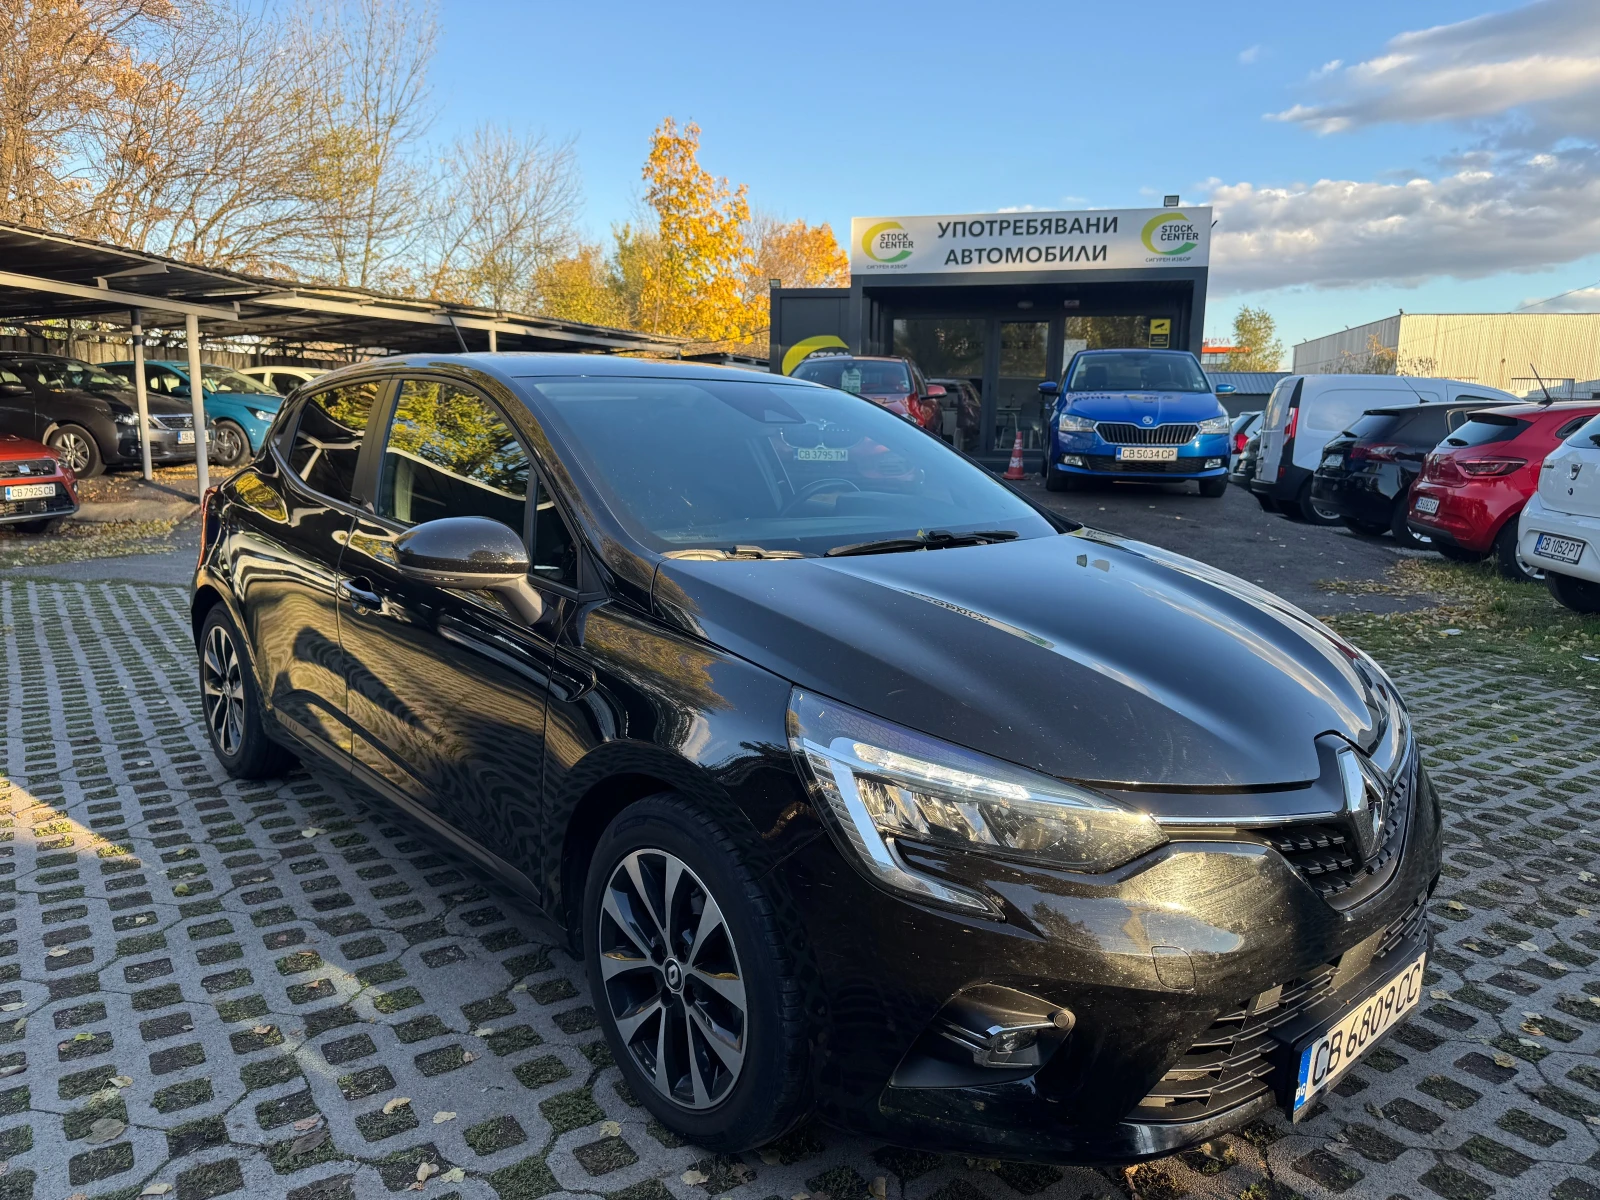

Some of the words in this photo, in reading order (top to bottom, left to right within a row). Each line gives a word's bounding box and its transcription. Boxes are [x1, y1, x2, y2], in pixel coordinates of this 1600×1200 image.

[937, 216, 1119, 239] УПОТРЕБЯВАНИ
[1161, 224, 1194, 233] STOCK
[880, 233, 909, 242] STOCK
[1160, 232, 1199, 242] CENTER
[879, 241, 914, 249] CENTER
[944, 244, 1108, 266] АВТОМОБИЛИ
[799, 450, 811, 459] CB
[812, 450, 833, 460] 3795
[1122, 449, 1135, 459] CB
[1136, 449, 1160, 459] 5034
[1161, 449, 1174, 459] CP
[11, 488, 23, 498] CB
[24, 487, 43, 497] 7925
[43, 486, 54, 495] CB
[1540, 537, 1552, 551] CB
[1551, 539, 1570, 556] 1052
[1567, 543, 1582, 558] PT
[1312, 1029, 1344, 1087] CB
[1345, 985, 1396, 1058] 6809
[1395, 962, 1421, 1015] CC
[1295, 1082, 1307, 1101] BG
